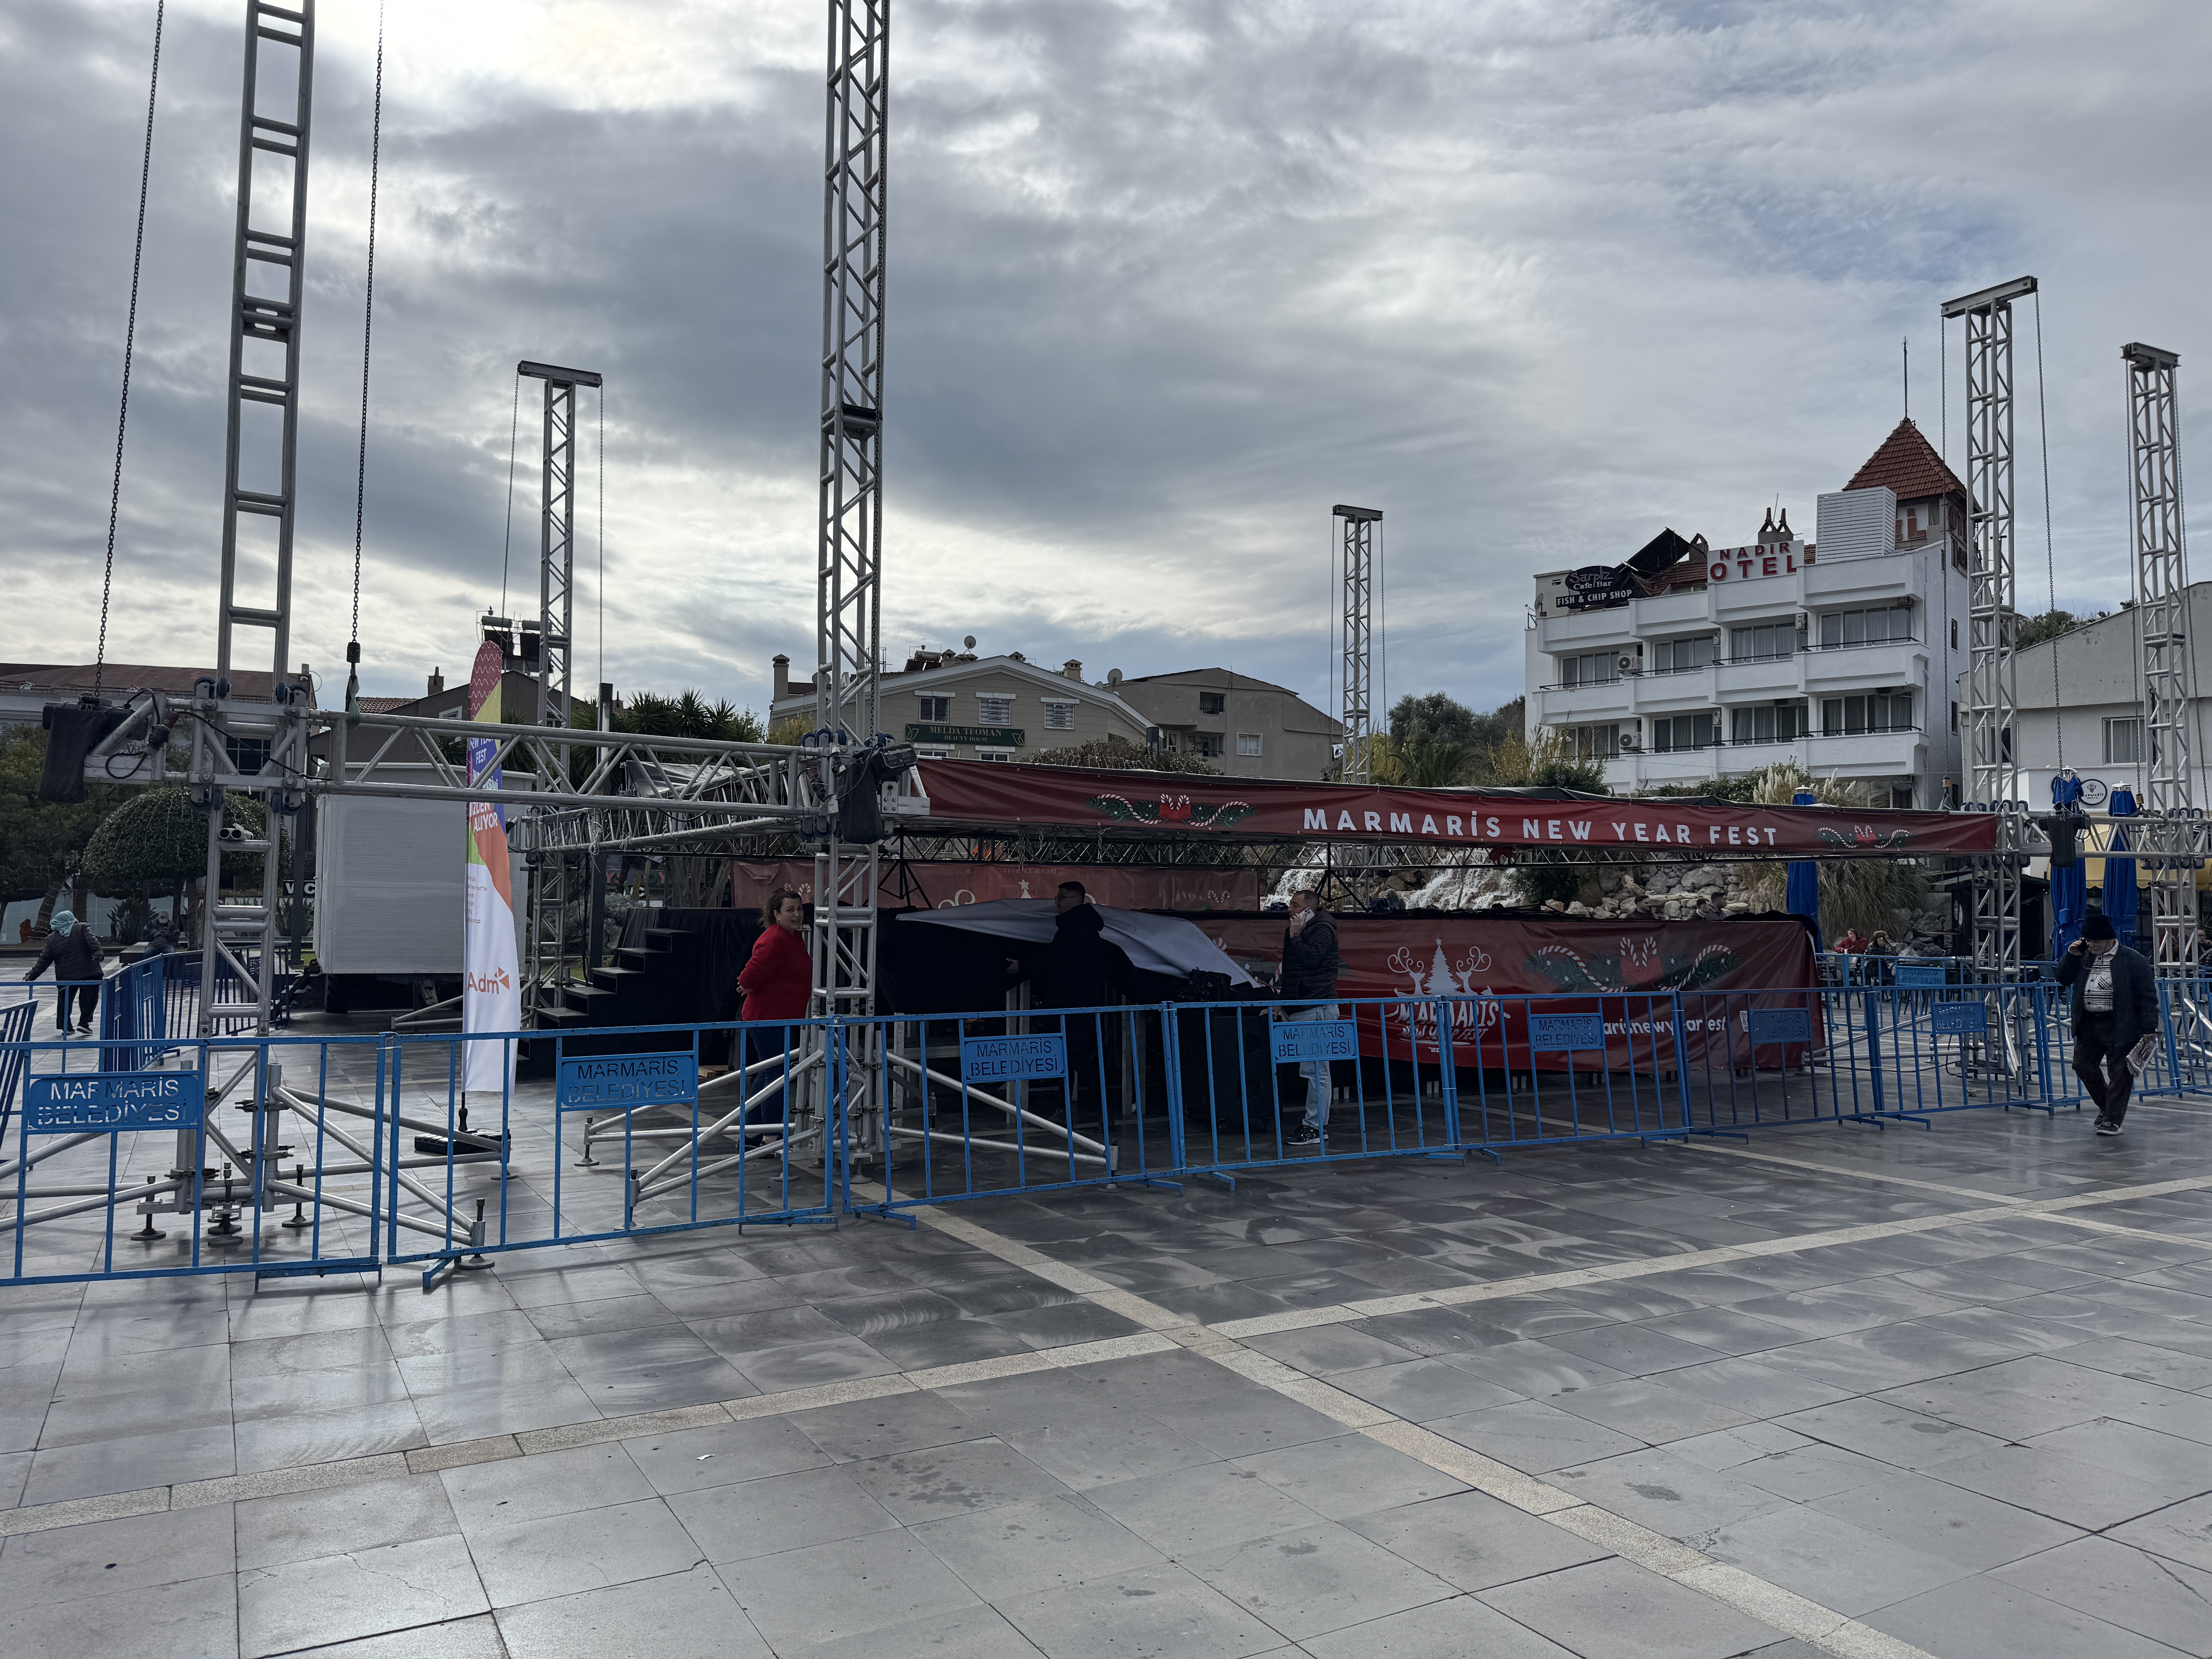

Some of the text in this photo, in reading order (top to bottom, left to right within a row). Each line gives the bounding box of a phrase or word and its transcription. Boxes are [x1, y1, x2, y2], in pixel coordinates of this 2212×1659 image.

[1720, 542, 1790, 560] NADİR
[1710, 555, 1797, 580] OTEL
[1557, 596, 1575, 605] FISH
[1588, 592, 1607, 601] CHIP
[1610, 590, 1632, 599] SHOP
[929, 726, 1002, 736] MELDA TEOMAN
[476, 748, 487, 765] FEST
[473, 812, 498, 833] ALIYOR
[1304, 808, 1776, 846] MARMARİS NEW YEAR FEST
[1283, 1024, 1345, 1040] MARMARİS
[977, 1038, 1051, 1057] MARMARİS
[578, 1057, 678, 1080] MARMARİS
[971, 1054, 1058, 1076] BELEDİYESİ
[568, 1076, 685, 1103] BELEDİYESİ
[38, 1098, 187, 1125] BELEDİYESİ
